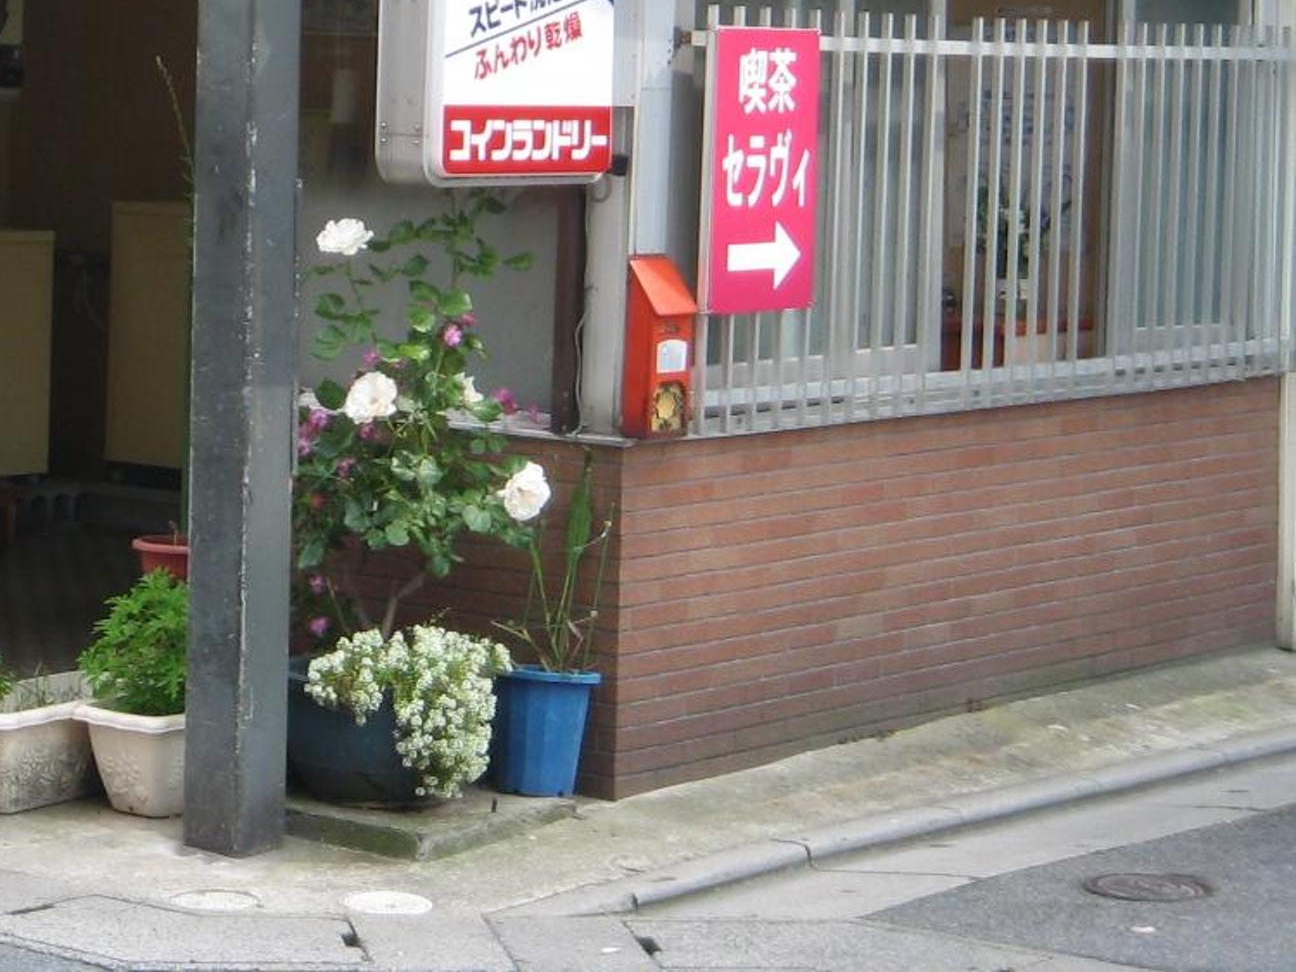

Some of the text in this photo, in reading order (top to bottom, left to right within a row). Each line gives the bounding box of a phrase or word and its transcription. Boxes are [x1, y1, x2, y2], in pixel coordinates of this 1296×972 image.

[474, 11, 582, 80] ふんわり乾燥
[738, 48, 797, 114] 喫茶
[449, 119, 608, 161] コインランドリー
[722, 129, 810, 207] セラヴィ
